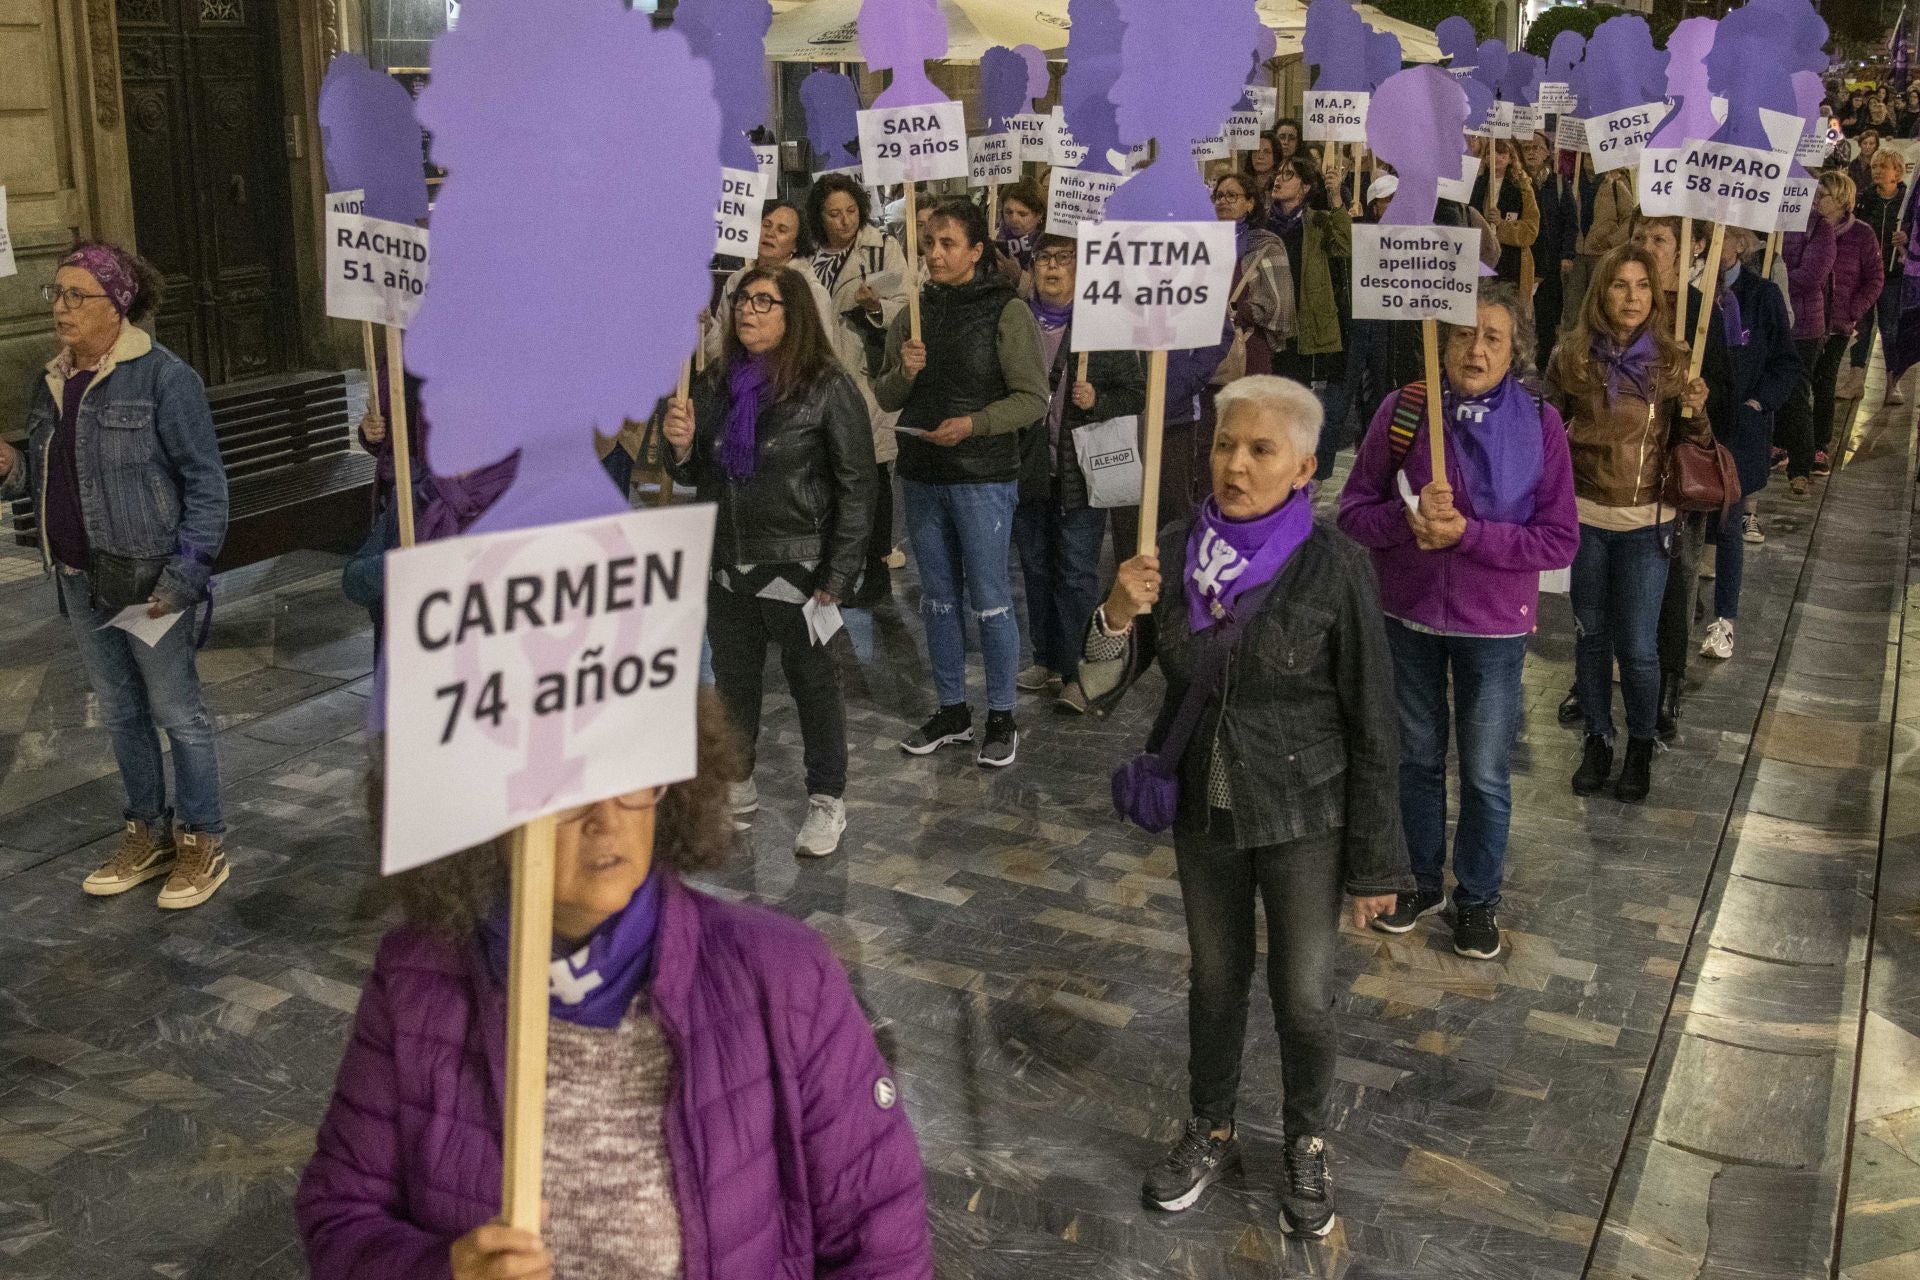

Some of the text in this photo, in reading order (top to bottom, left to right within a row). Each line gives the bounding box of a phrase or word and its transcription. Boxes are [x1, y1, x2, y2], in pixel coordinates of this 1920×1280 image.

[1314, 98, 1356, 109] M.A.P.
[884, 115, 941, 134] SARA
[1309, 113, 1361, 125] 48 años
[1608, 113, 1651, 133] ROSI
[1230, 128, 1255, 136] años
[877, 138, 959, 159] 29 años
[984, 139, 1006, 151] MARI
[1021, 135, 1044, 146] ños
[1599, 132, 1652, 152] 67 año
[973, 151, 1012, 163] ÁNGELES
[1064, 151, 1077, 159] 59
[973, 165, 1012, 177] 66 años
[1653, 159, 1678, 174] LO
[1685, 151, 1781, 180] AMPARO
[1060, 176, 1117, 192] Niño y niñ
[1685, 175, 1771, 203] 58 años
[1783, 186, 1809, 197] UELA
[1055, 189, 1100, 203] mellizos
[1054, 201, 1083, 213] años.
[1780, 203, 1801, 213] ños
[715, 220, 749, 242] ños
[337, 228, 428, 264] RACHID
[1085, 232, 1211, 266] FÁTIMA
[1379, 237, 1463, 255] Nombre y
[1379, 256, 1457, 272] apellidos
[343, 260, 425, 296] 51 año
[1360, 275, 1473, 294] desconocidos
[1082, 279, 1209, 306] 44 años
[1381, 294, 1453, 311] 50 años.
[1094, 452, 1130, 467] ALE-HOP
[415, 550, 685, 652] CARMEN
[434, 646, 679, 747] 74 años
